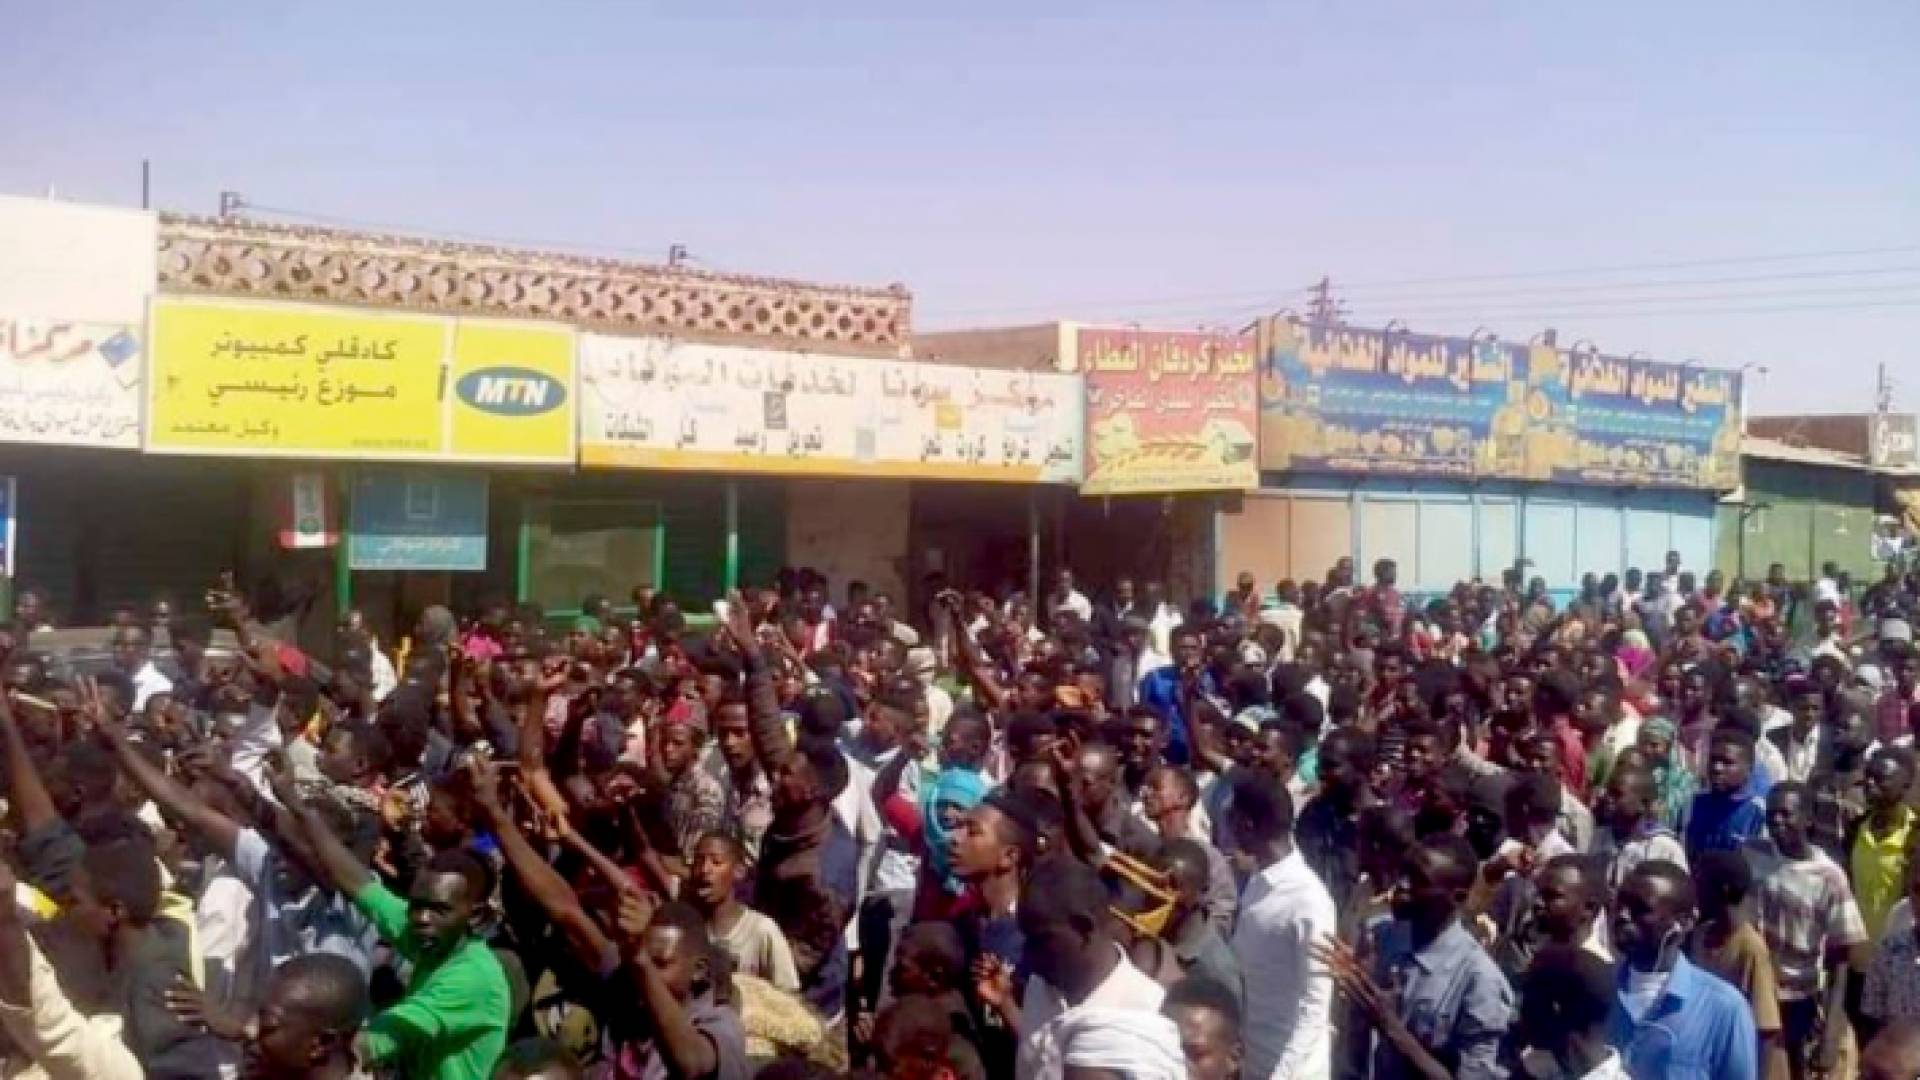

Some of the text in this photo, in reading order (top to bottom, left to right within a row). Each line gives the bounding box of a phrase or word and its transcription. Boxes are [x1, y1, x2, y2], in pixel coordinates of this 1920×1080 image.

[209, 330, 308, 360] كمبيوتر
[206, 371, 397, 408] موزع رئيسي
[476, 375, 548, 406] MTN
